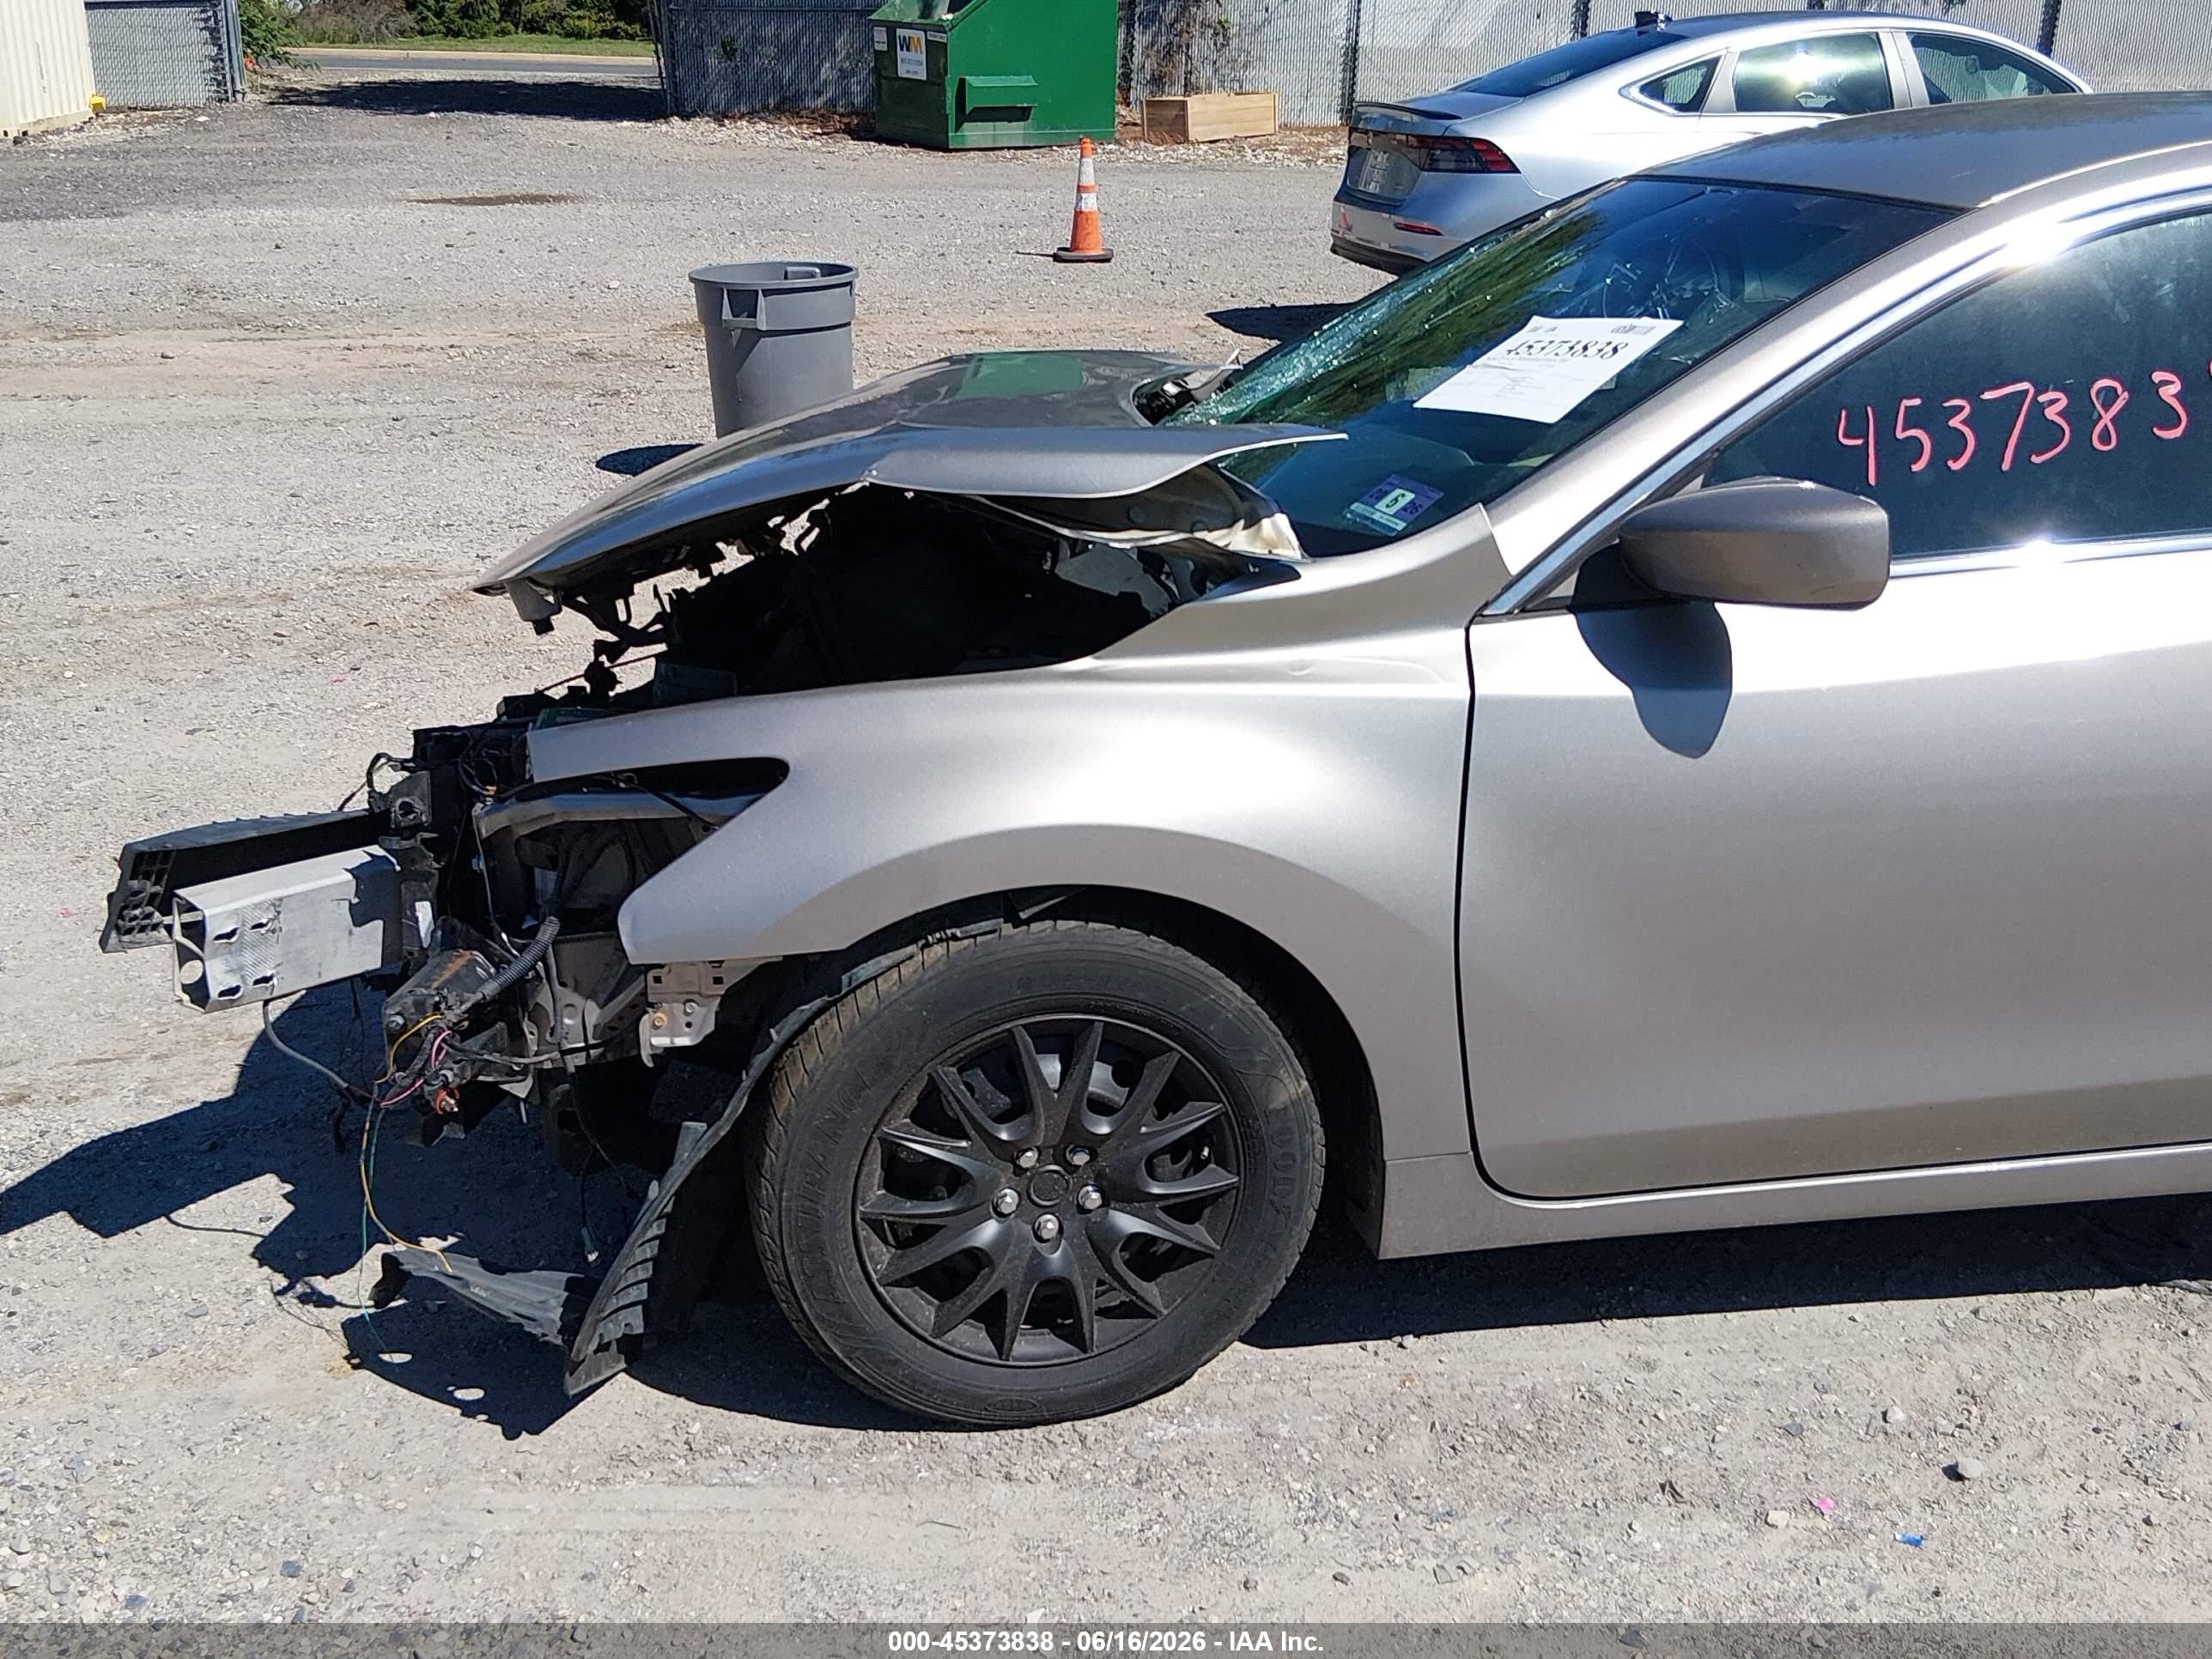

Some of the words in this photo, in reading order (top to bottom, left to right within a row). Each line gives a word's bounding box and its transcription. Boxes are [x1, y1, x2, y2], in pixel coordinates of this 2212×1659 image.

[898, 34, 923, 54] WM
[1506, 340, 1630, 359] 45373838
[1837, 358, 2212, 487] 4537383
